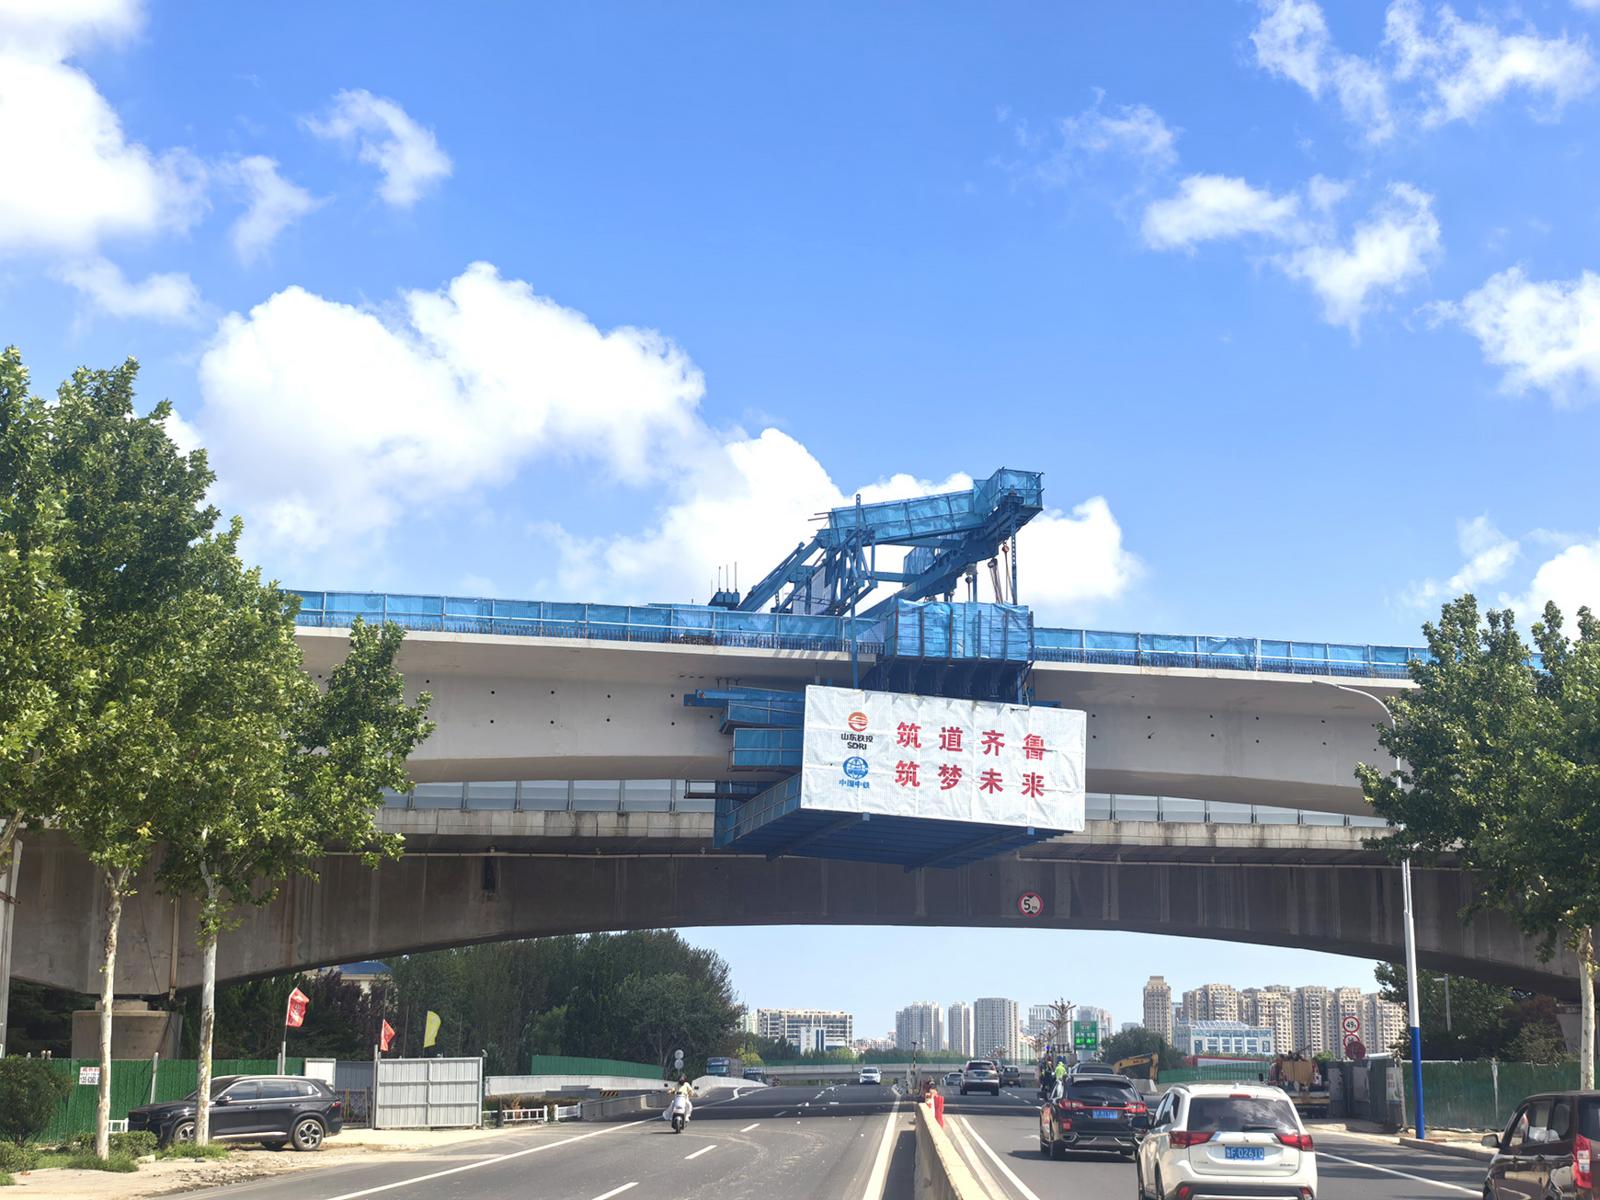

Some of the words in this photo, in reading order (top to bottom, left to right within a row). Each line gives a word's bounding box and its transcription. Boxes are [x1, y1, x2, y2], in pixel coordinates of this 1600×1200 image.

[847, 741, 867, 750] SDRI
[896, 721, 1046, 761] 筑道齐鲁
[895, 760, 1045, 798] 筑梦未来
